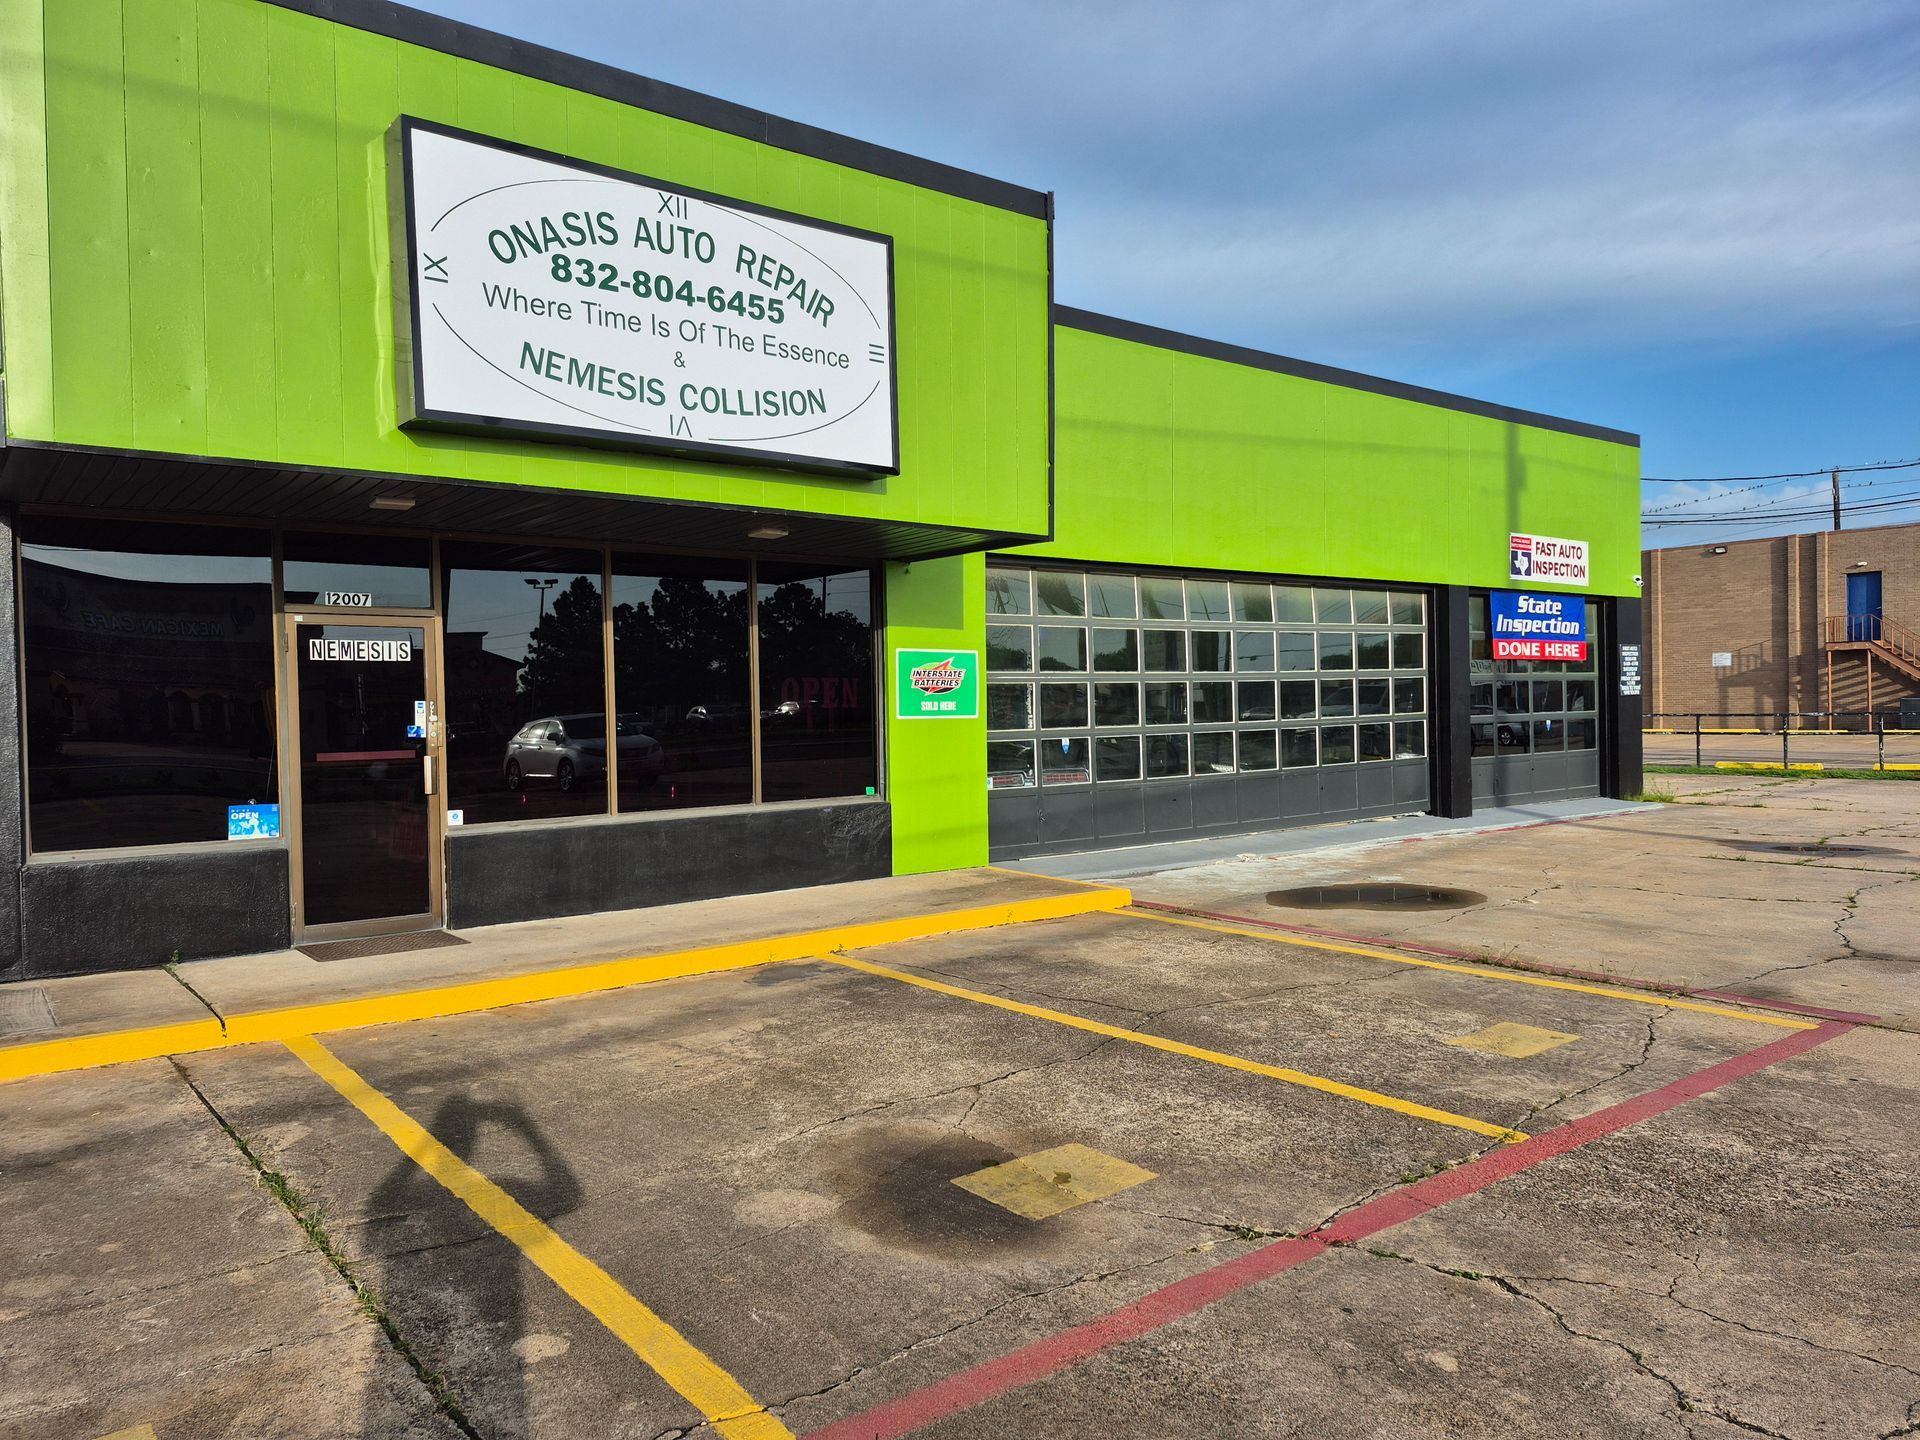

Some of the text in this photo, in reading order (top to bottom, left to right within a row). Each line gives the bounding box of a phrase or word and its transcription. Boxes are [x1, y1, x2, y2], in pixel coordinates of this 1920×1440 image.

[657, 191, 688, 220] XII
[487, 211, 836, 328] ONASIS AUTO REPAIR
[551, 253, 785, 325] 832-804-6455
[482, 282, 850, 370] Where Time Is Of The Essence
[673, 351, 686, 369] &
[519, 341, 827, 417] NEMESIS COLLISION
[1535, 541, 1557, 557] FAST
[1559, 544, 1583, 560] AUTO
[1532, 560, 1586, 578] INSPECTION
[326, 592, 370, 606] 12007
[1517, 595, 1562, 615] State
[1496, 613, 1580, 637] Inspection
[311, 640, 410, 661] NEMESIS
[1498, 641, 1580, 658] DONE HERE
[912, 670, 963, 678] INTERSTATE
[914, 679, 960, 687] BATTERIES
[781, 675, 860, 709] OPEN
[920, 701, 939, 711] SOLD
[231, 812, 259, 820] OPEN
